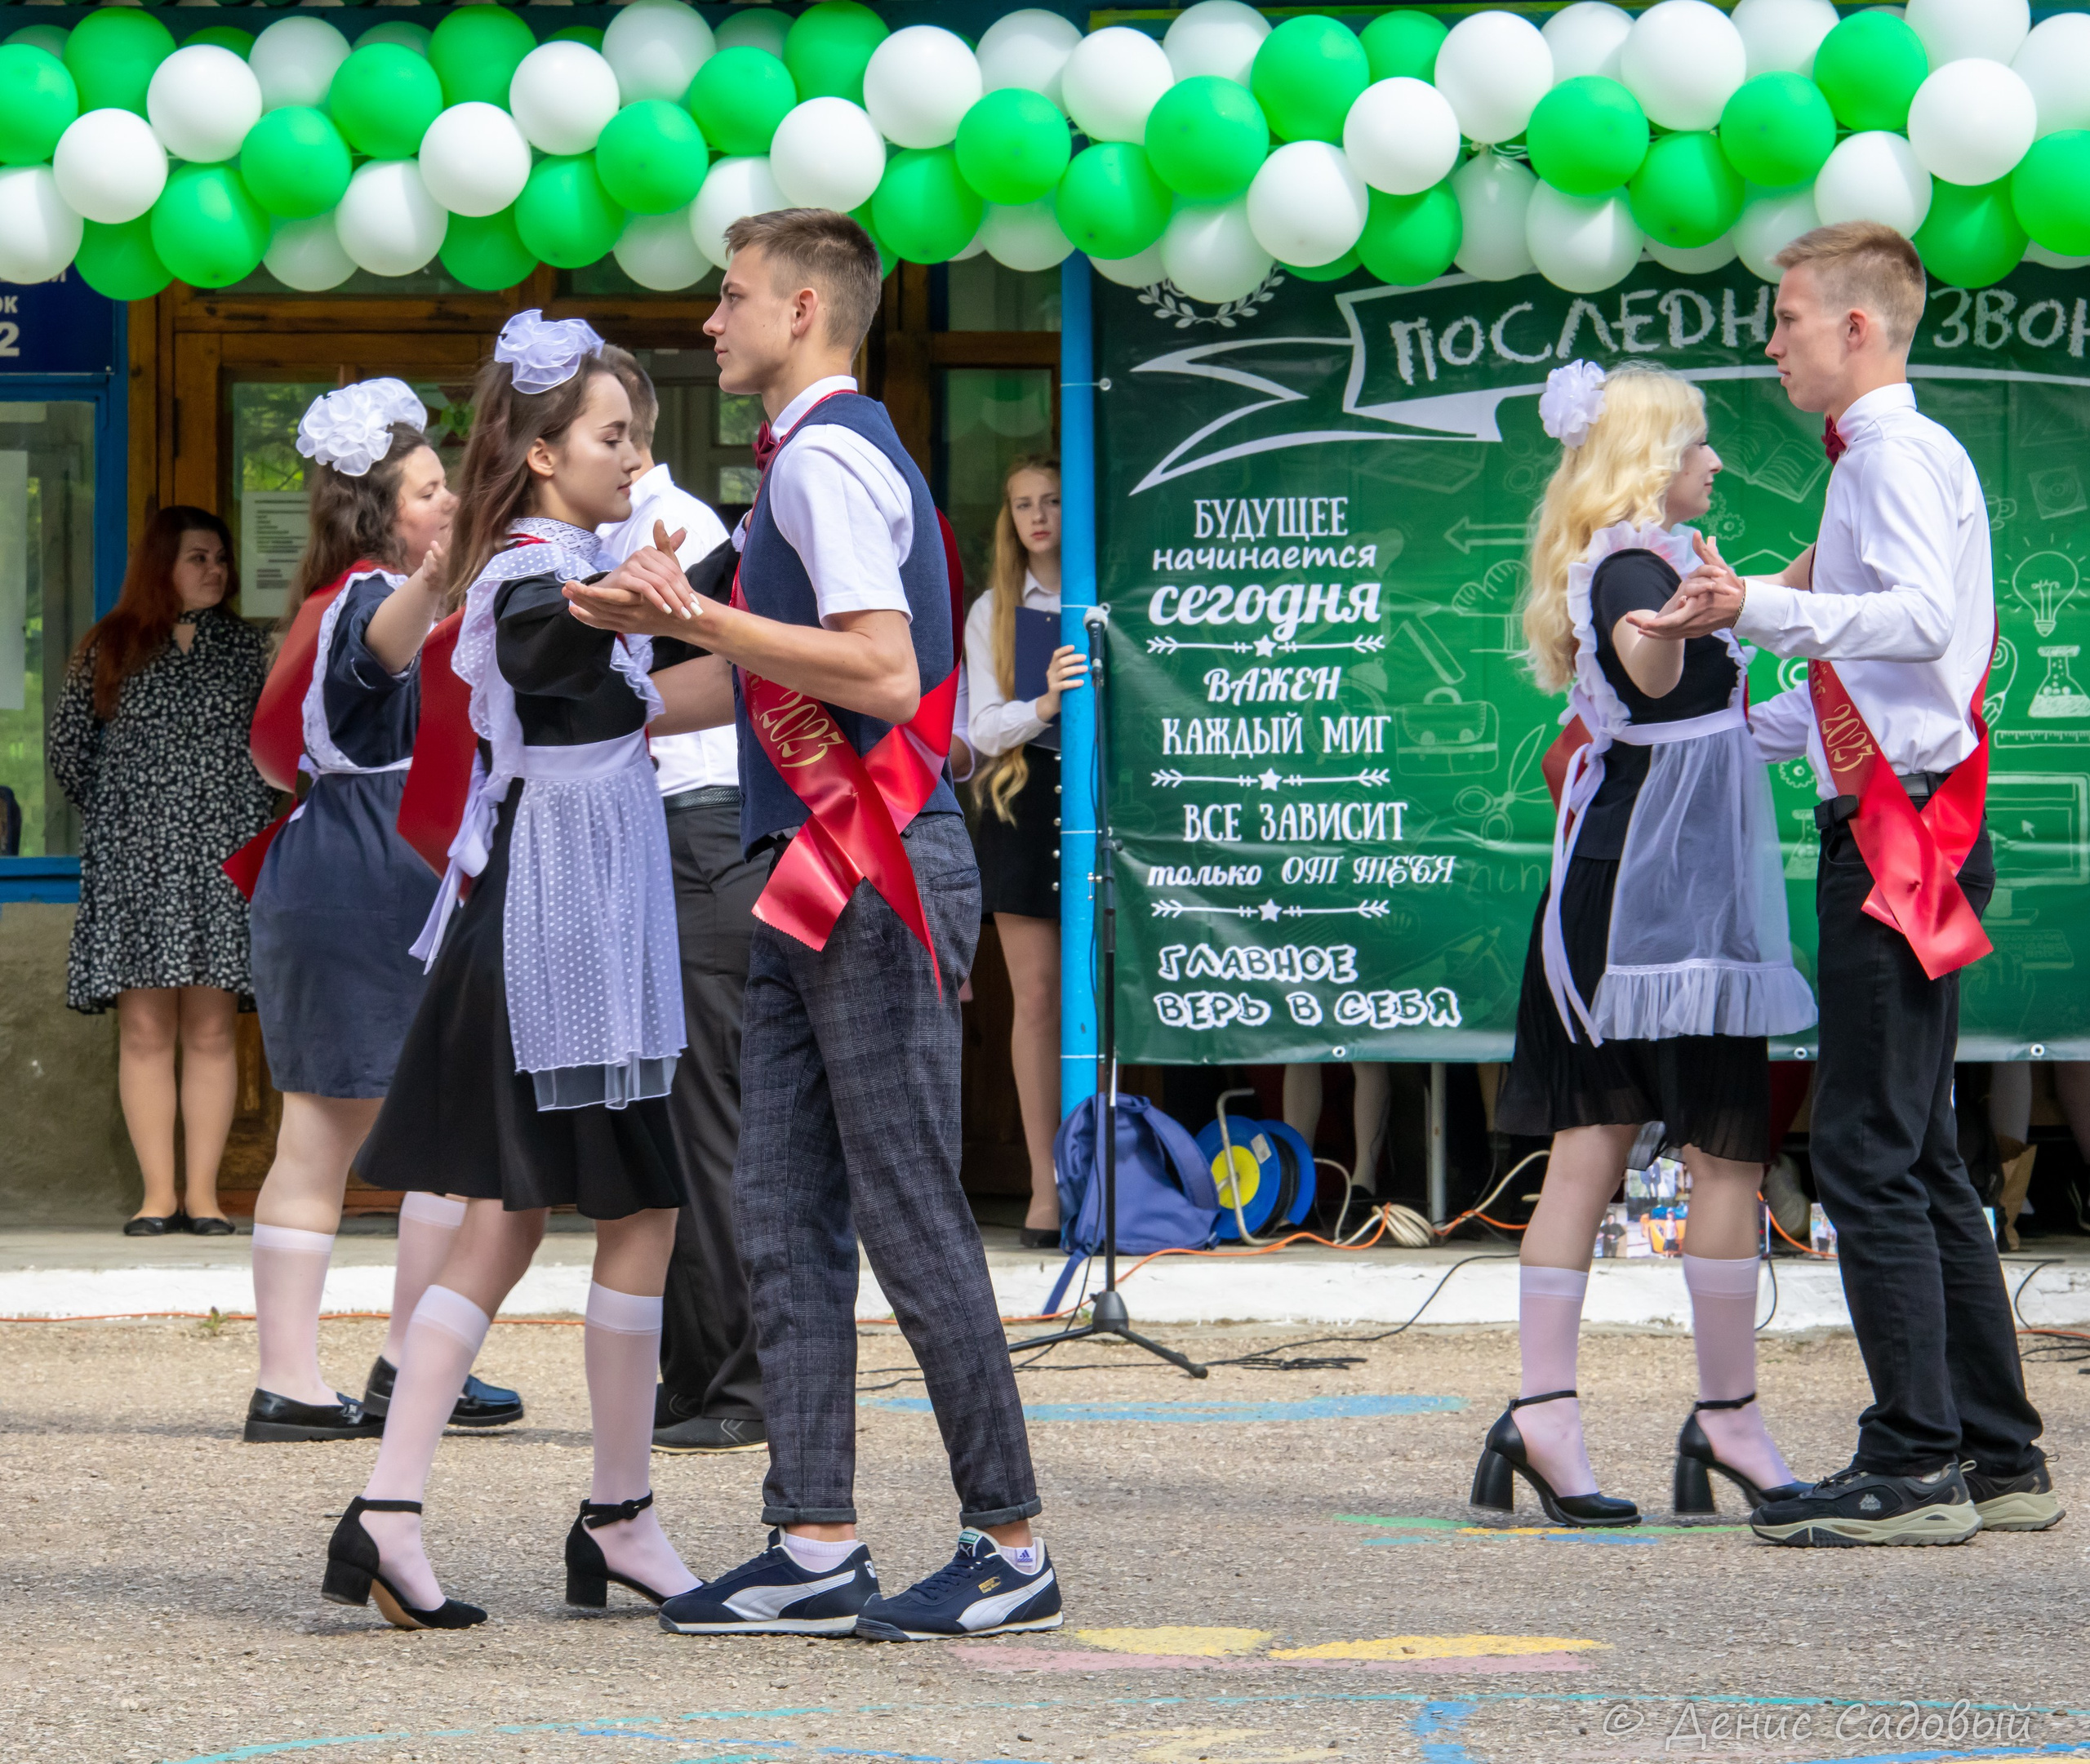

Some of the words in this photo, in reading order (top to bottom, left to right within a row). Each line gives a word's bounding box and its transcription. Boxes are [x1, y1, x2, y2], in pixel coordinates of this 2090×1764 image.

[1390, 286, 1779, 386] ПОСЛЕДН
[1194, 497, 1348, 543] БУДУЩЕЕ
[1152, 544, 1376, 571] начинается
[1148, 583, 1384, 641] сегодня
[1203, 666, 1341, 706] ВАЖЕН
[758, 690, 845, 768] 2023
[1161, 712, 1304, 759] КАЖДЫЙ
[1320, 715, 1391, 753] МИГ
[1820, 703, 1876, 772] 2023
[1182, 803, 1242, 842] ВСЕ
[1259, 802, 1408, 841] ЗАВИСИТ
[1146, 864, 1262, 886] только
[1281, 855, 1344, 884] ОТ
[1353, 855, 1456, 889] ТЕБЯ
[1158, 943, 1358, 984] ГЛАВНОЕ
[1153, 990, 1271, 1031] ВЕРЬ
[1285, 990, 1323, 1026] В
[1333, 987, 1462, 1030] СЕБЯ
